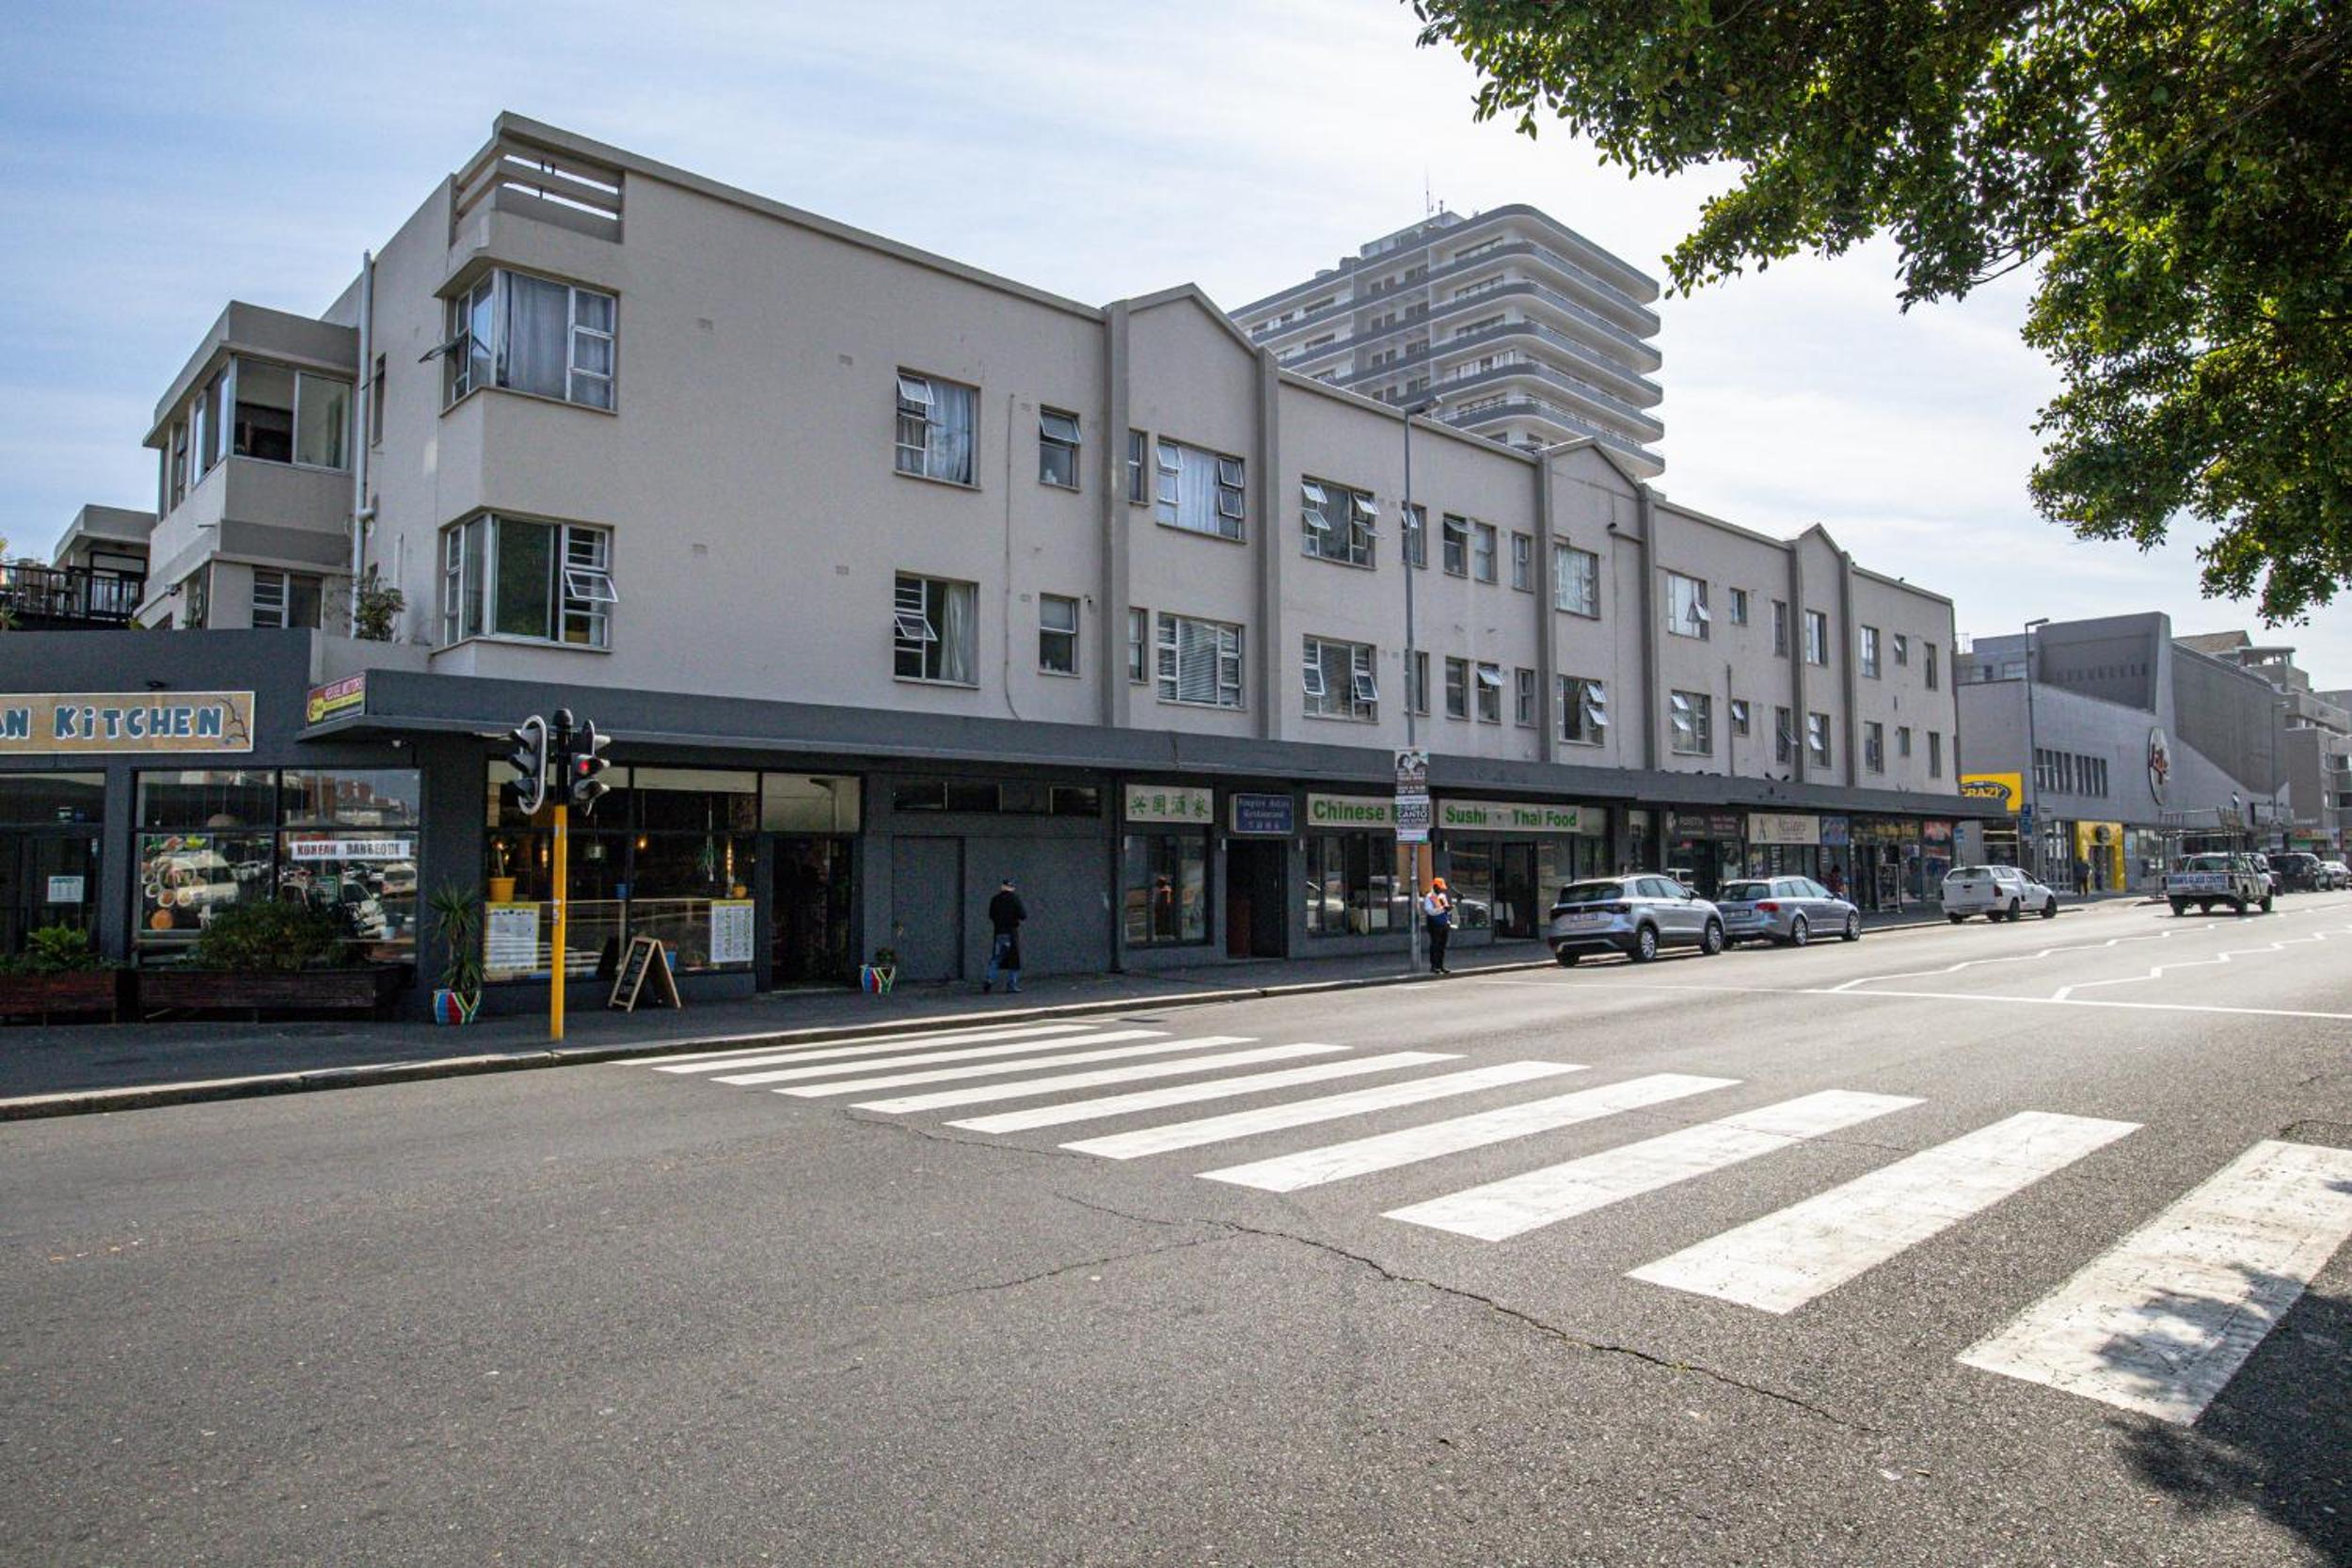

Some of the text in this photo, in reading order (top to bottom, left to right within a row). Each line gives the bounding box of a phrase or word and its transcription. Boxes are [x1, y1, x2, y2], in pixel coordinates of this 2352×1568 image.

[0, 707, 30, 738] N
[1313, 800, 1385, 820] Chinese
[1445, 805, 1486, 825] Sushi
[1512, 809, 1542, 826] Thai
[1547, 810, 1577, 827] Food
[297, 844, 337, 856] KOREAN
